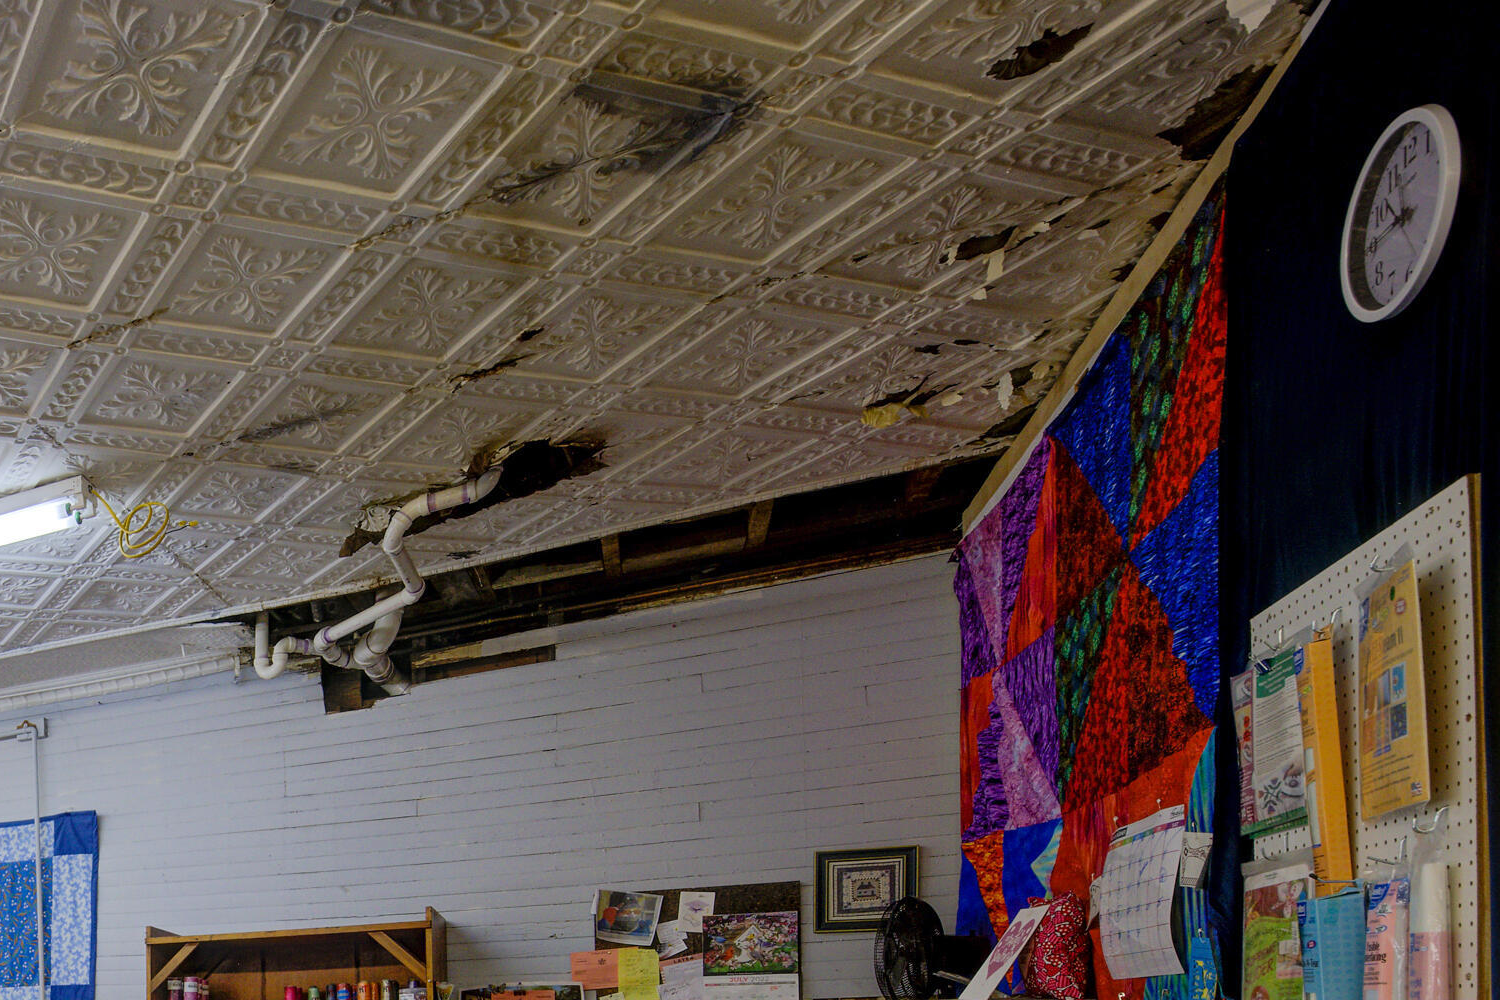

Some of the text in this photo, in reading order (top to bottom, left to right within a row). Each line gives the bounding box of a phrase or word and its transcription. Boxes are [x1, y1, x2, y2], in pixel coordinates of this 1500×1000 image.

[1403, 135, 1418, 169] 12
[1388, 164, 1402, 197] 11
[1374, 198, 1389, 229] 10
[1375, 260, 1384, 286] 8
